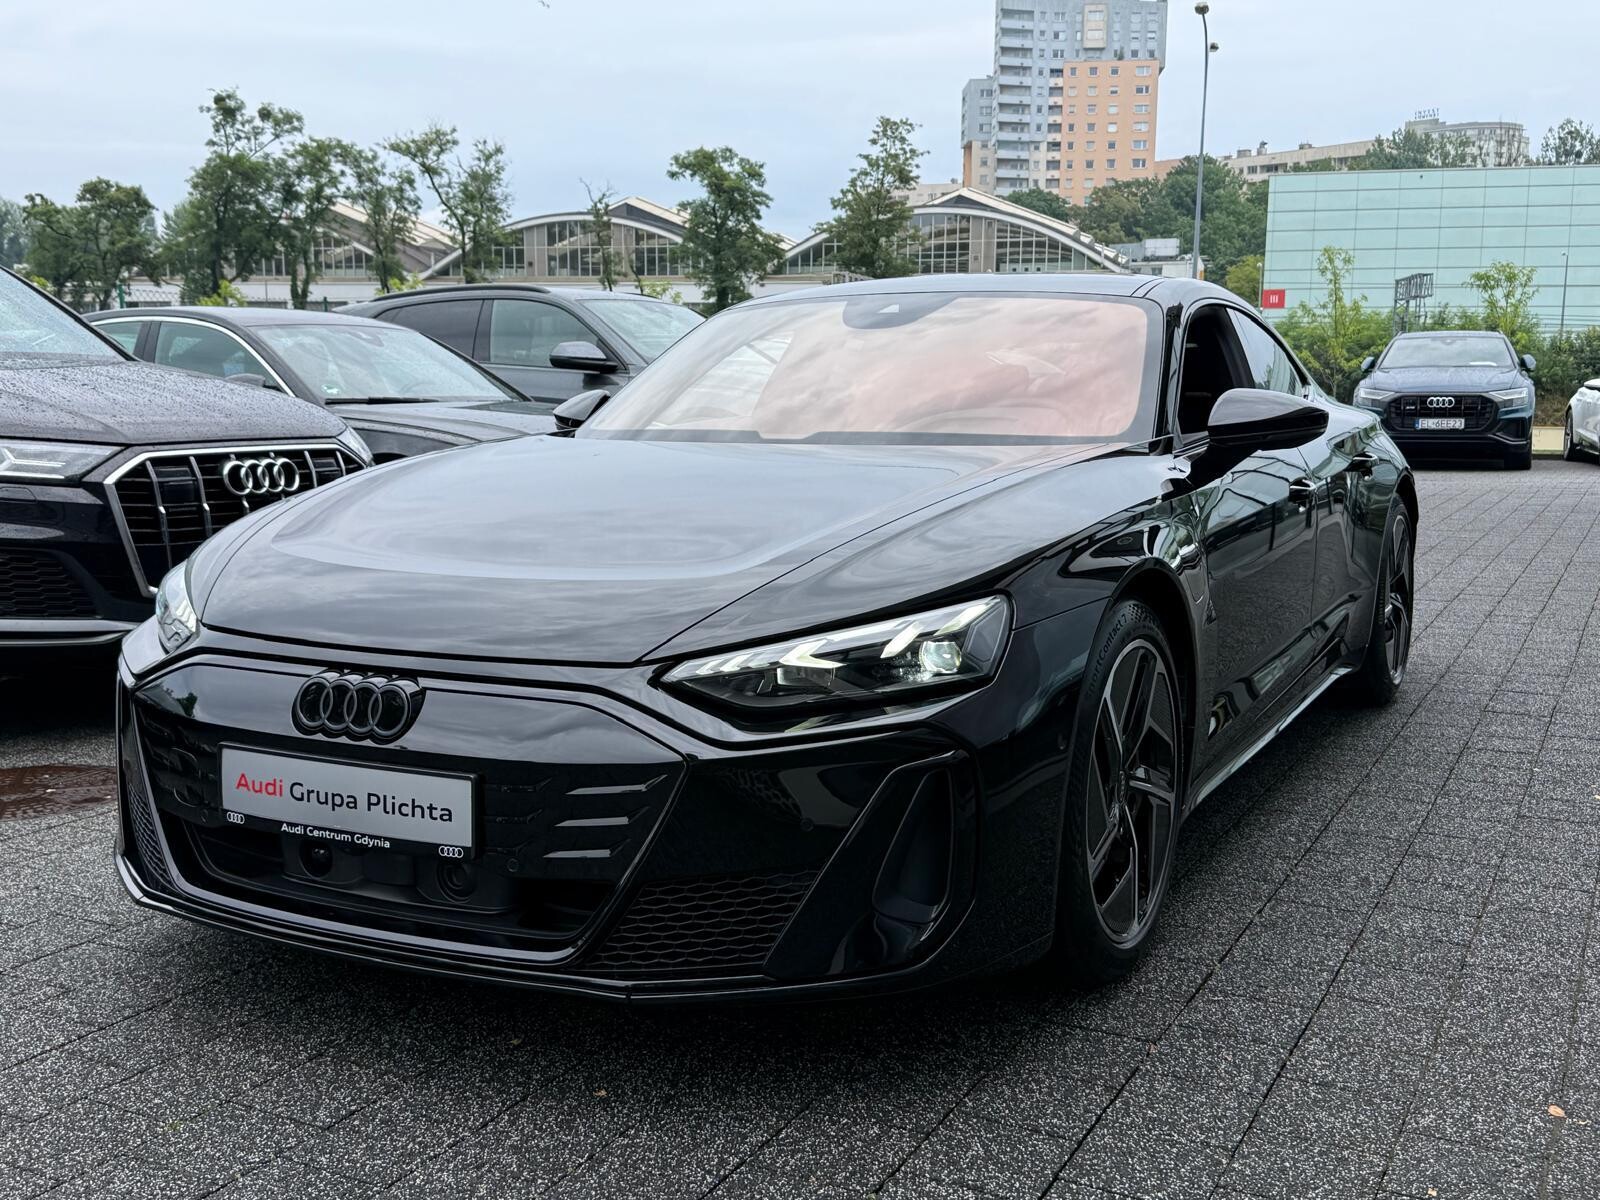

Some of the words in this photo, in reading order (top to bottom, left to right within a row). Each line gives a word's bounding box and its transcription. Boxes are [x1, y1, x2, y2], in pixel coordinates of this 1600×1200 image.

[1421, 420, 1431, 428] EL
[1087, 619, 1124, 696] portContact
[235, 772, 283, 797] Audi
[290, 782, 358, 811] Grupa
[367, 793, 453, 822] Plichta
[281, 823, 304, 835] Audi
[306, 827, 351, 842] Centrum
[354, 834, 390, 848] Gdynia
